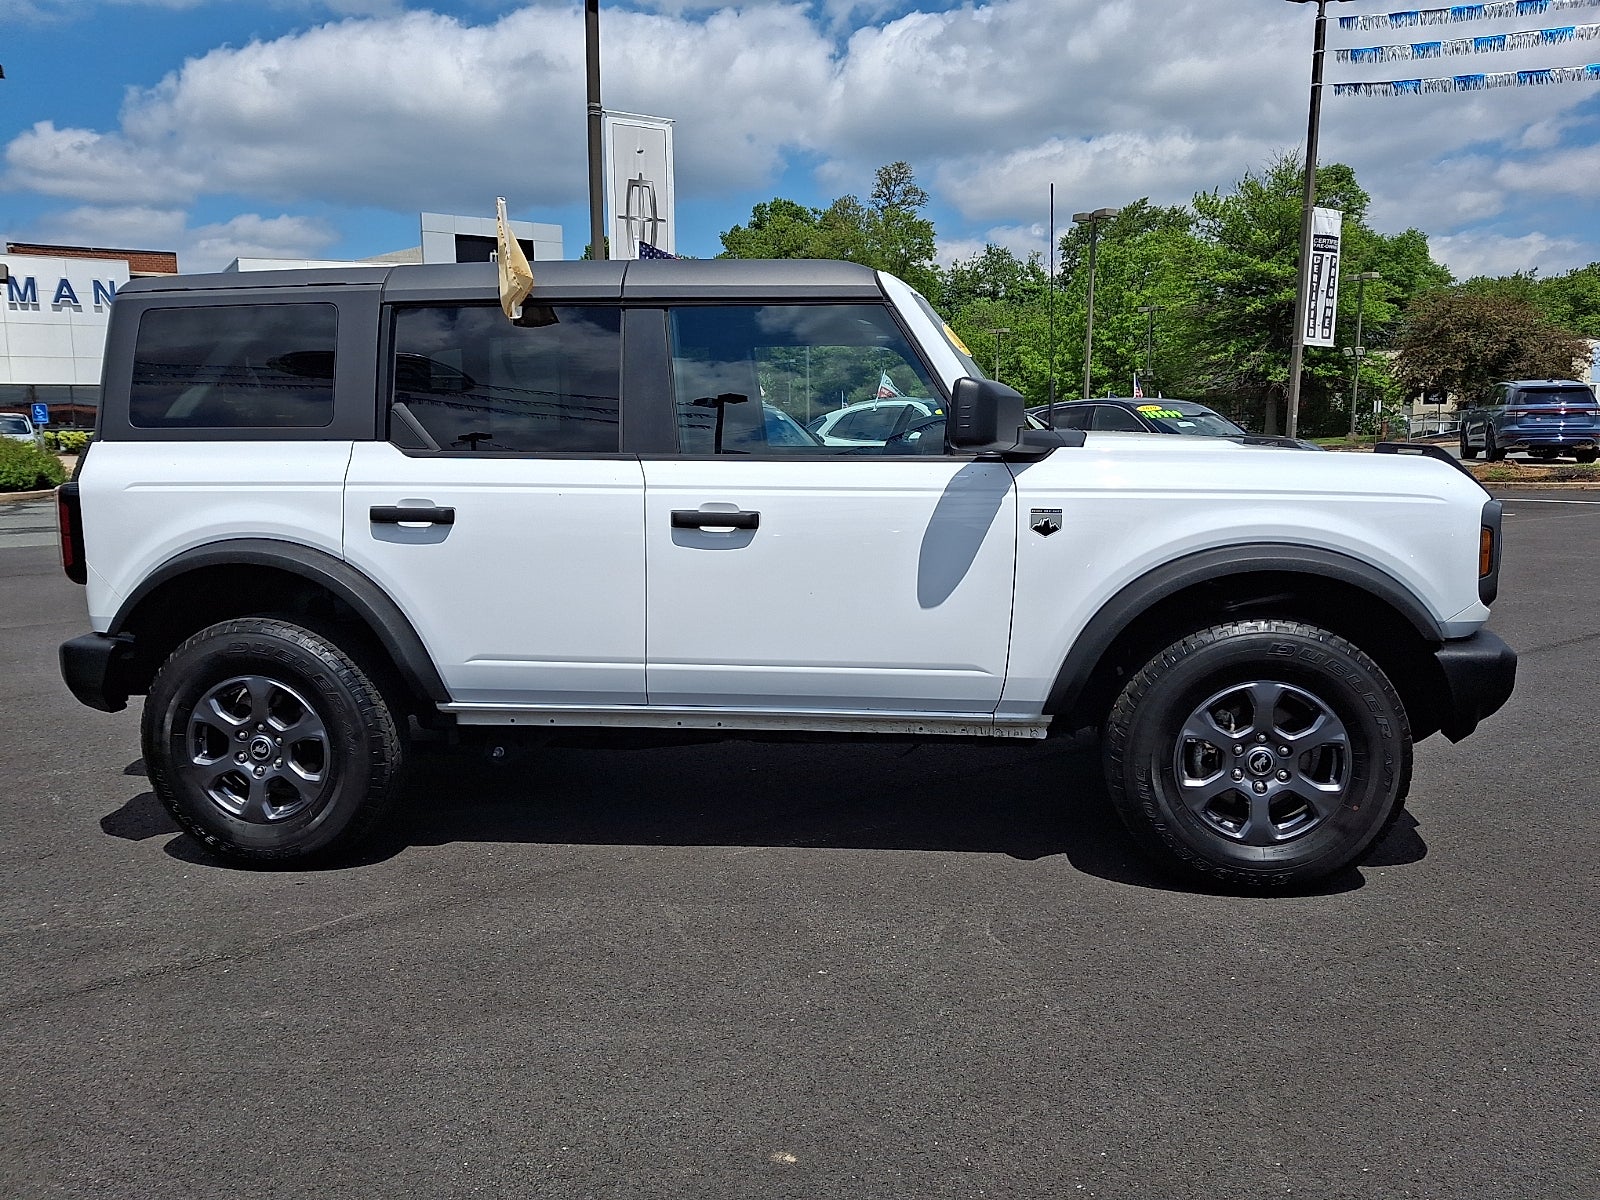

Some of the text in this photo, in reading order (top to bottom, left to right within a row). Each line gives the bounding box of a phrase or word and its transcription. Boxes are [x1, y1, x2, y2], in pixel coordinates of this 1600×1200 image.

[1313, 237, 1338, 246] CERTIFIE
[1308, 255, 1322, 337] CERTIFIED
[1323, 256, 1337, 338] PREOWNED
[227, 641, 347, 714] DUELER
[1266, 641, 1394, 740] DUELER
